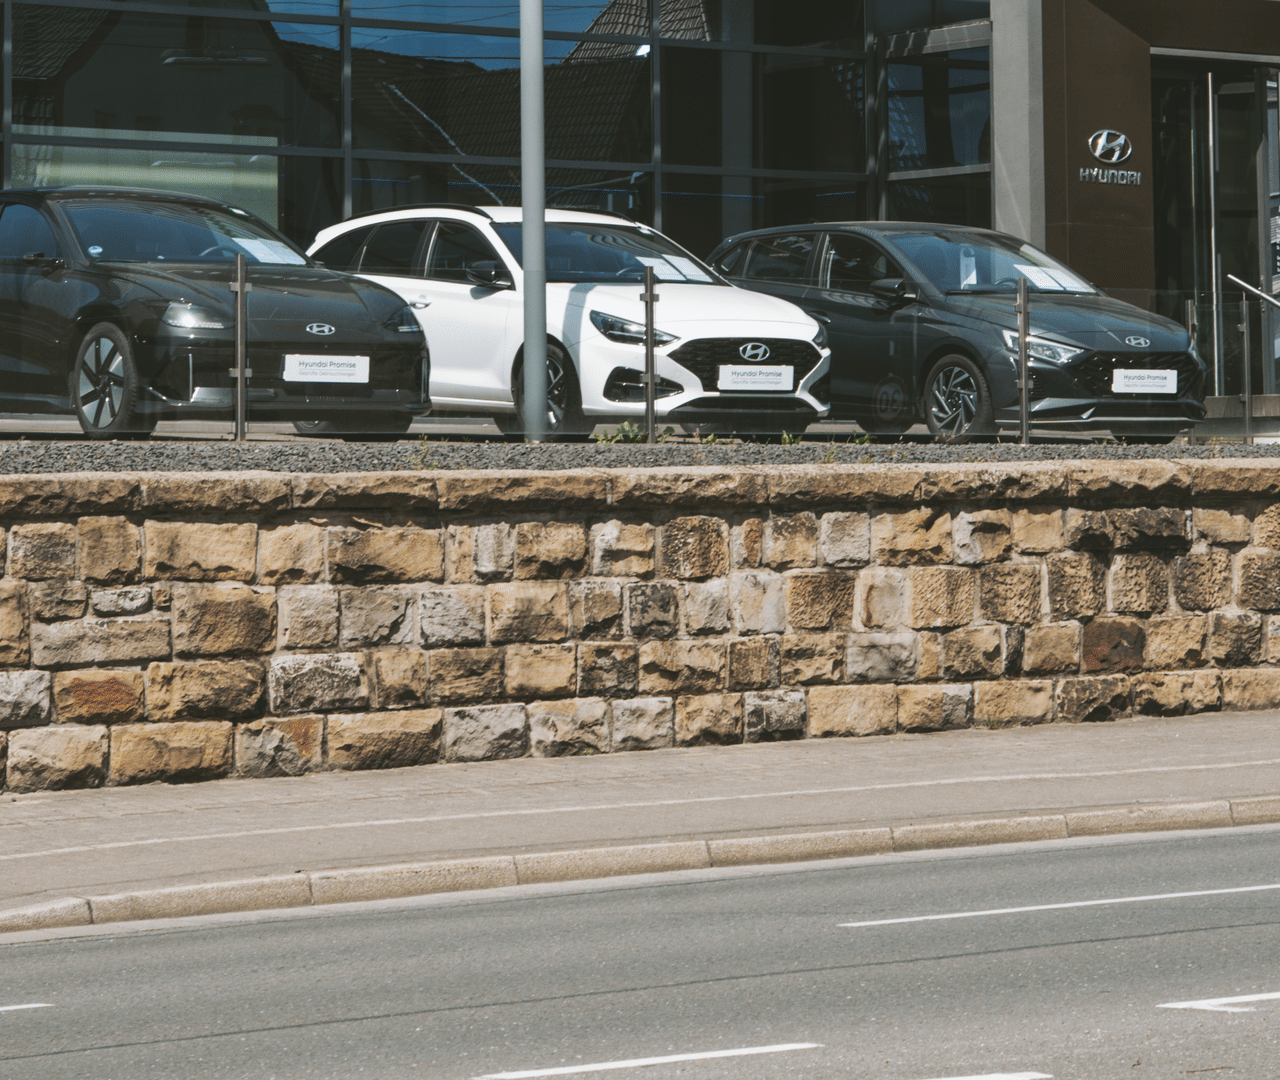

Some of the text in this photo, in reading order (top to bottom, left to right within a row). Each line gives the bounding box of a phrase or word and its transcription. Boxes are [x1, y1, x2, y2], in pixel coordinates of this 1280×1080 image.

[1079, 167, 1142, 186] HYUNDAI
[299, 360, 356, 368] Hyundai Promise
[731, 370, 757, 378] Hyundai
